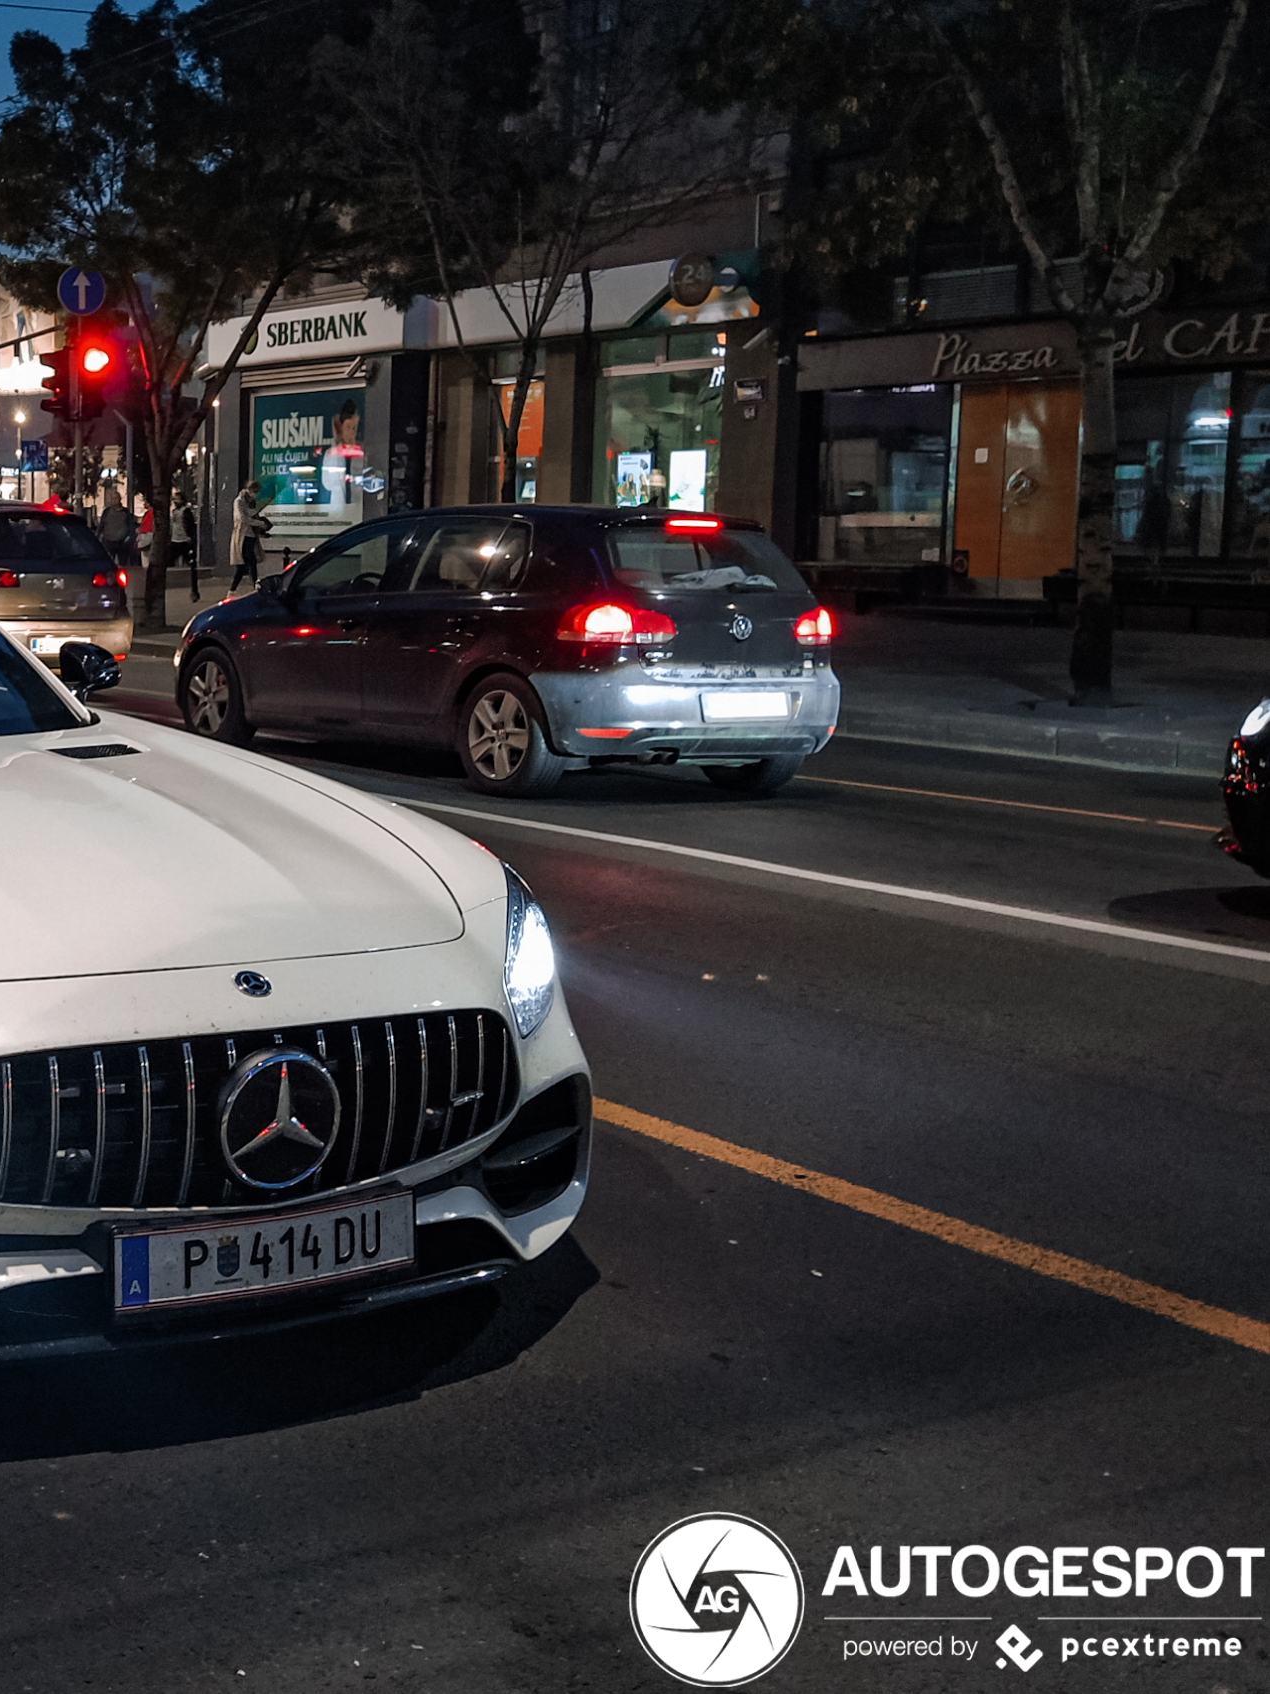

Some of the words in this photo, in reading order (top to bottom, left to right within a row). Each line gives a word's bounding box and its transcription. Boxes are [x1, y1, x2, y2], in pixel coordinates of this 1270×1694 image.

[266, 311, 368, 348] SBERBANK
[932, 332, 1058, 376] Piazza
[1113, 322, 1144, 362] el
[261, 411, 334, 450] SLUŠAM...
[261, 453, 273, 463] ALI
[274, 452, 284, 462] NE
[183, 1239, 208, 1289] P
[249, 1223, 322, 1278] 414
[334, 1209, 380, 1265] DU
[129, 1280, 141, 1295] A
